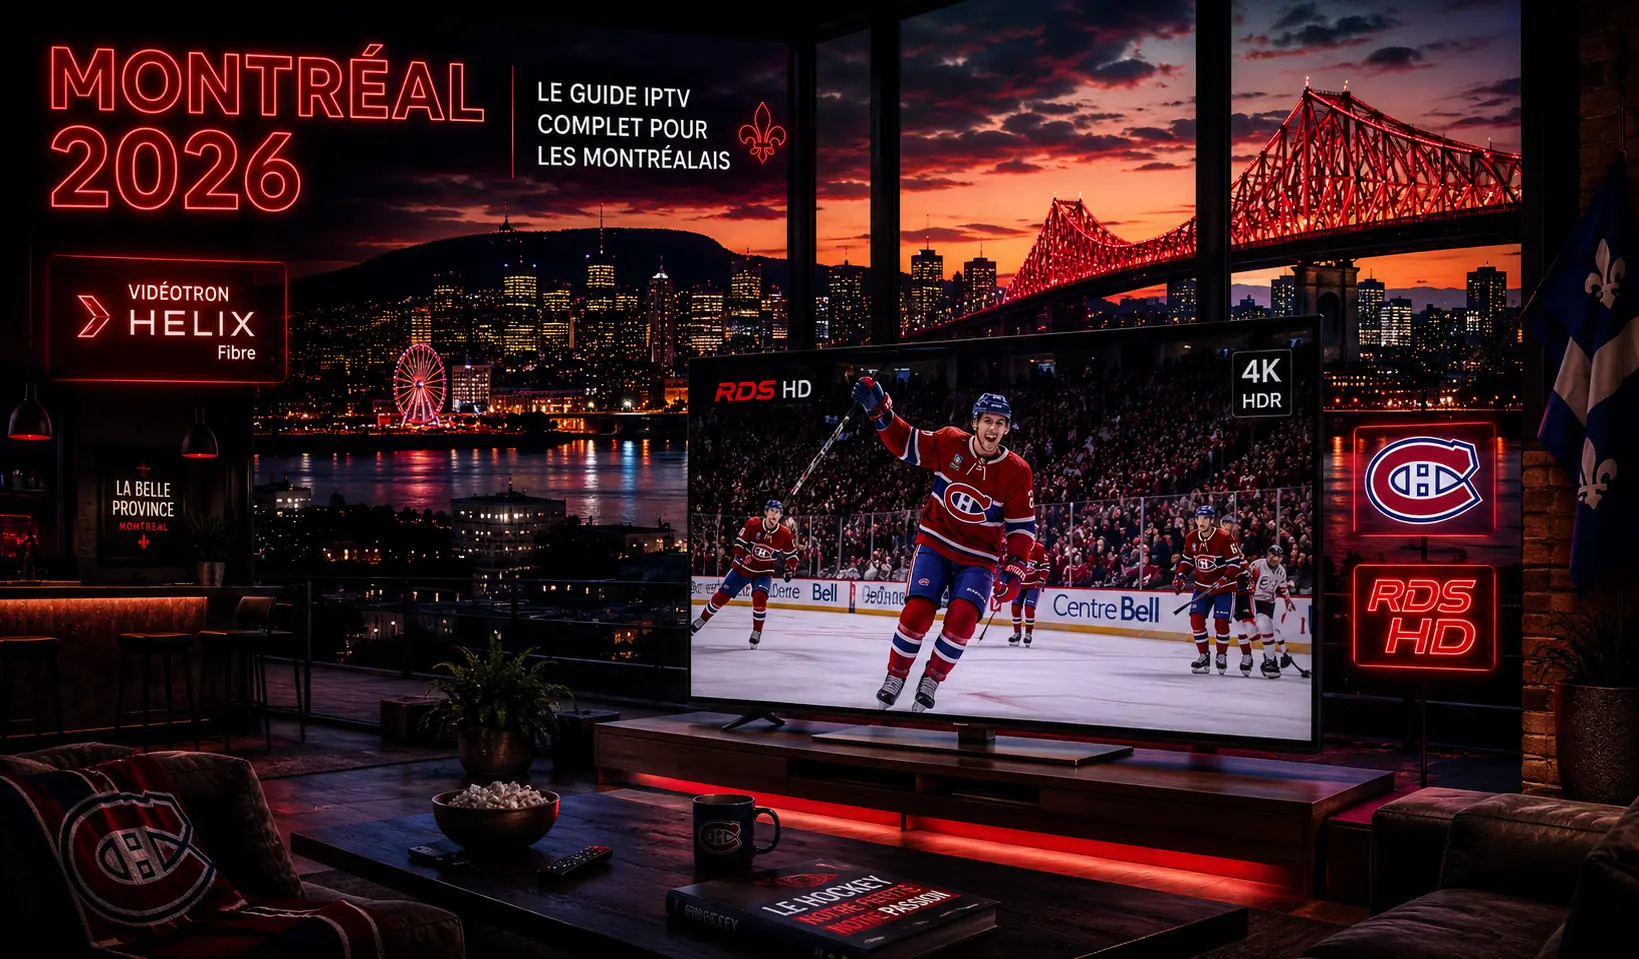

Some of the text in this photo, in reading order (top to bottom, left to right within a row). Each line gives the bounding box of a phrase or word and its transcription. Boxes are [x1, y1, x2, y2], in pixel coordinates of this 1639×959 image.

[128, 280, 230, 302] VIDÉOTRON
[129, 309, 256, 337] HELIX
[218, 344, 256, 360] Fibre
[1241, 358, 1282, 384] 4K
[714, 379, 812, 402] RDS HD
[1242, 392, 1282, 410] HDR
[116, 480, 171, 498] LA BELLE
[112, 500, 175, 517] PROVINCE
[812, 583, 838, 603] Bell
[1367, 578, 1476, 615] RDS
[1053, 593, 1160, 623] Centre Bell
[1384, 617, 1477, 656] HD
[761, 874, 893, 917] LE HOCKEY
[877, 889, 952, 917] PASSION
